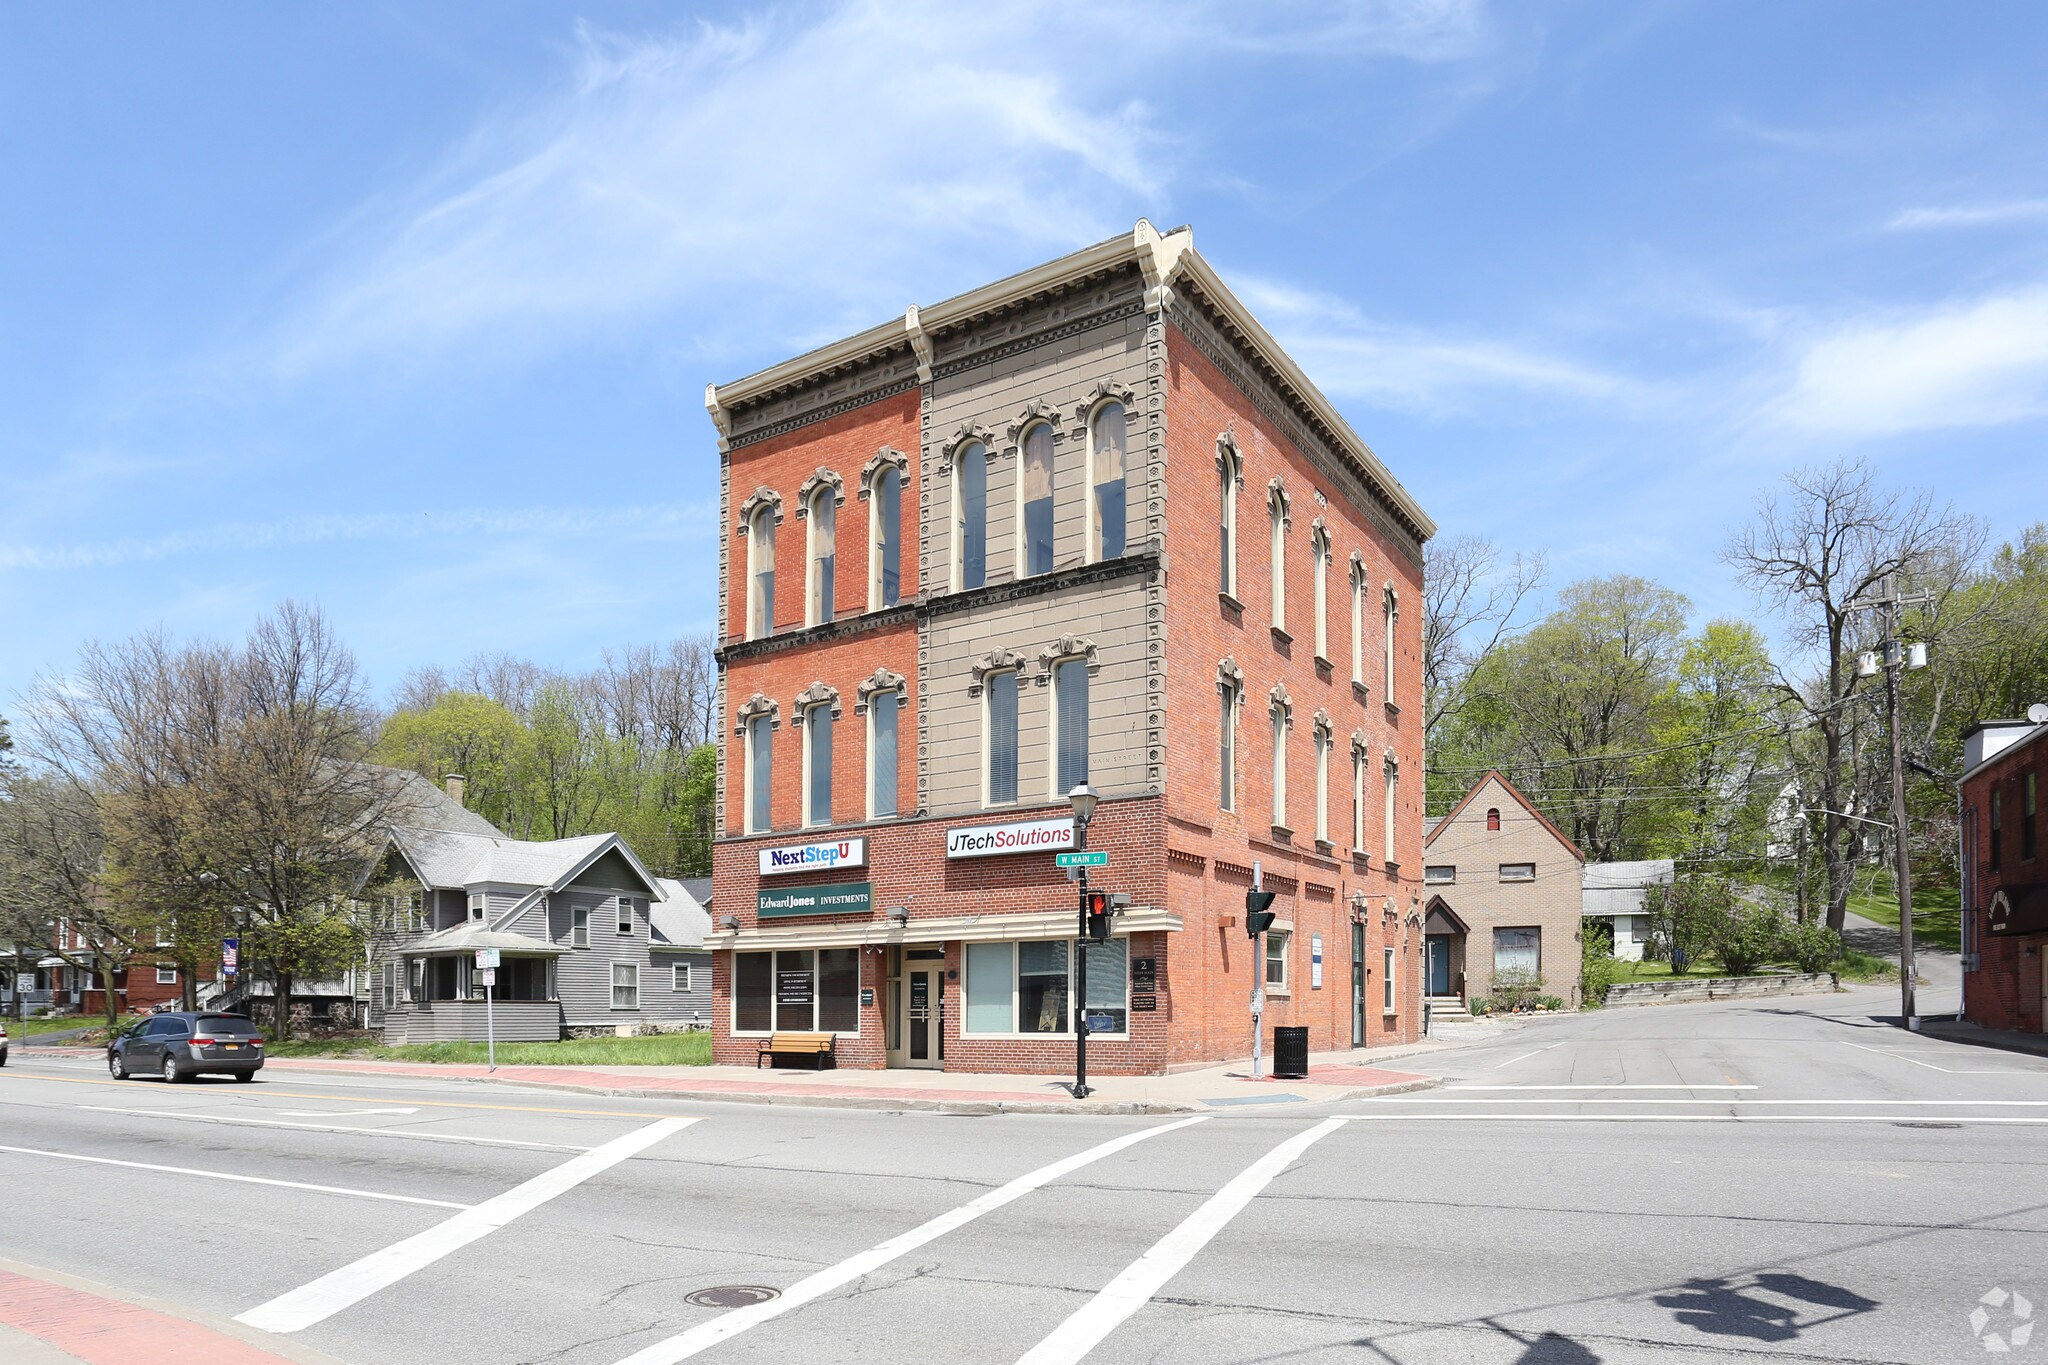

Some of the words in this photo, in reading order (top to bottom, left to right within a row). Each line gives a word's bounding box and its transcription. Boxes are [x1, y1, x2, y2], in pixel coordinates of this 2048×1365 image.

[1113, 753, 1142, 762] STREET
[949, 827, 1071, 852] JTechSolutions
[771, 842, 850, 867] NextStepU
[1061, 856, 1068, 864] W
[1071, 855, 1090, 864] MAIN
[820, 893, 869, 905] INVESTMENTS
[1140, 961, 1147, 970] 2
